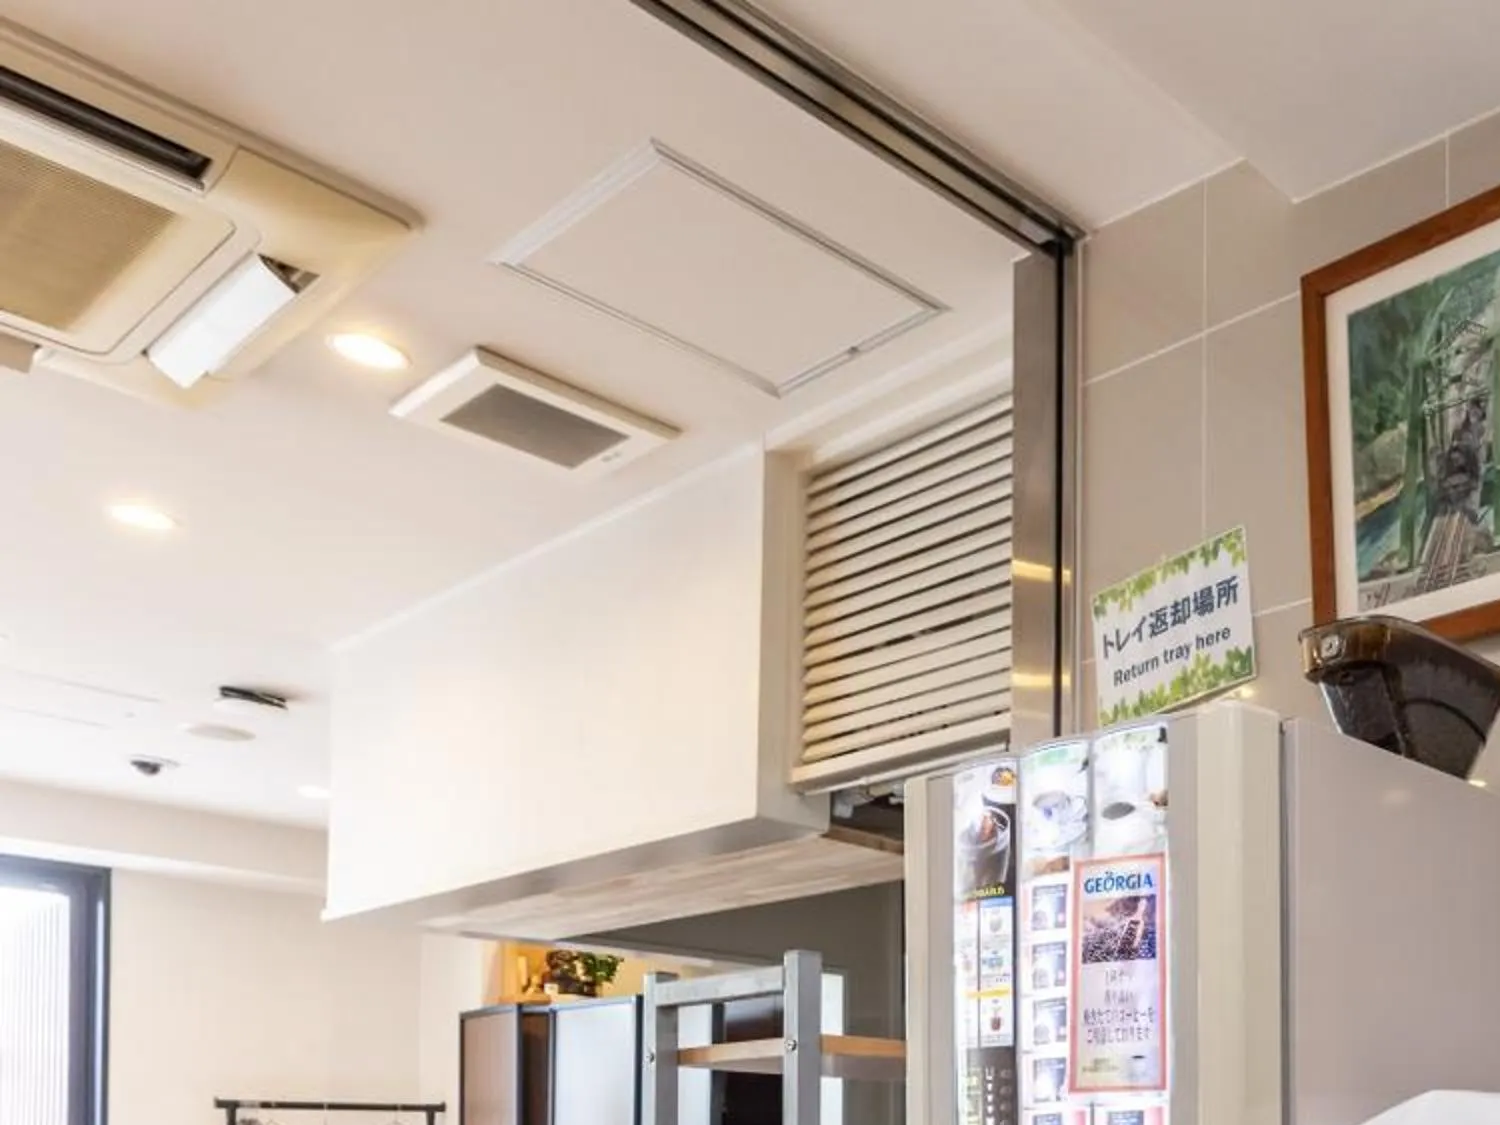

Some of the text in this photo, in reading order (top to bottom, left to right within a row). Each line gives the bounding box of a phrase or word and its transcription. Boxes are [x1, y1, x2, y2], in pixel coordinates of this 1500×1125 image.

[1103, 575, 1239, 659] トレイ返却場所
[1113, 627, 1231, 687] Return tray here
